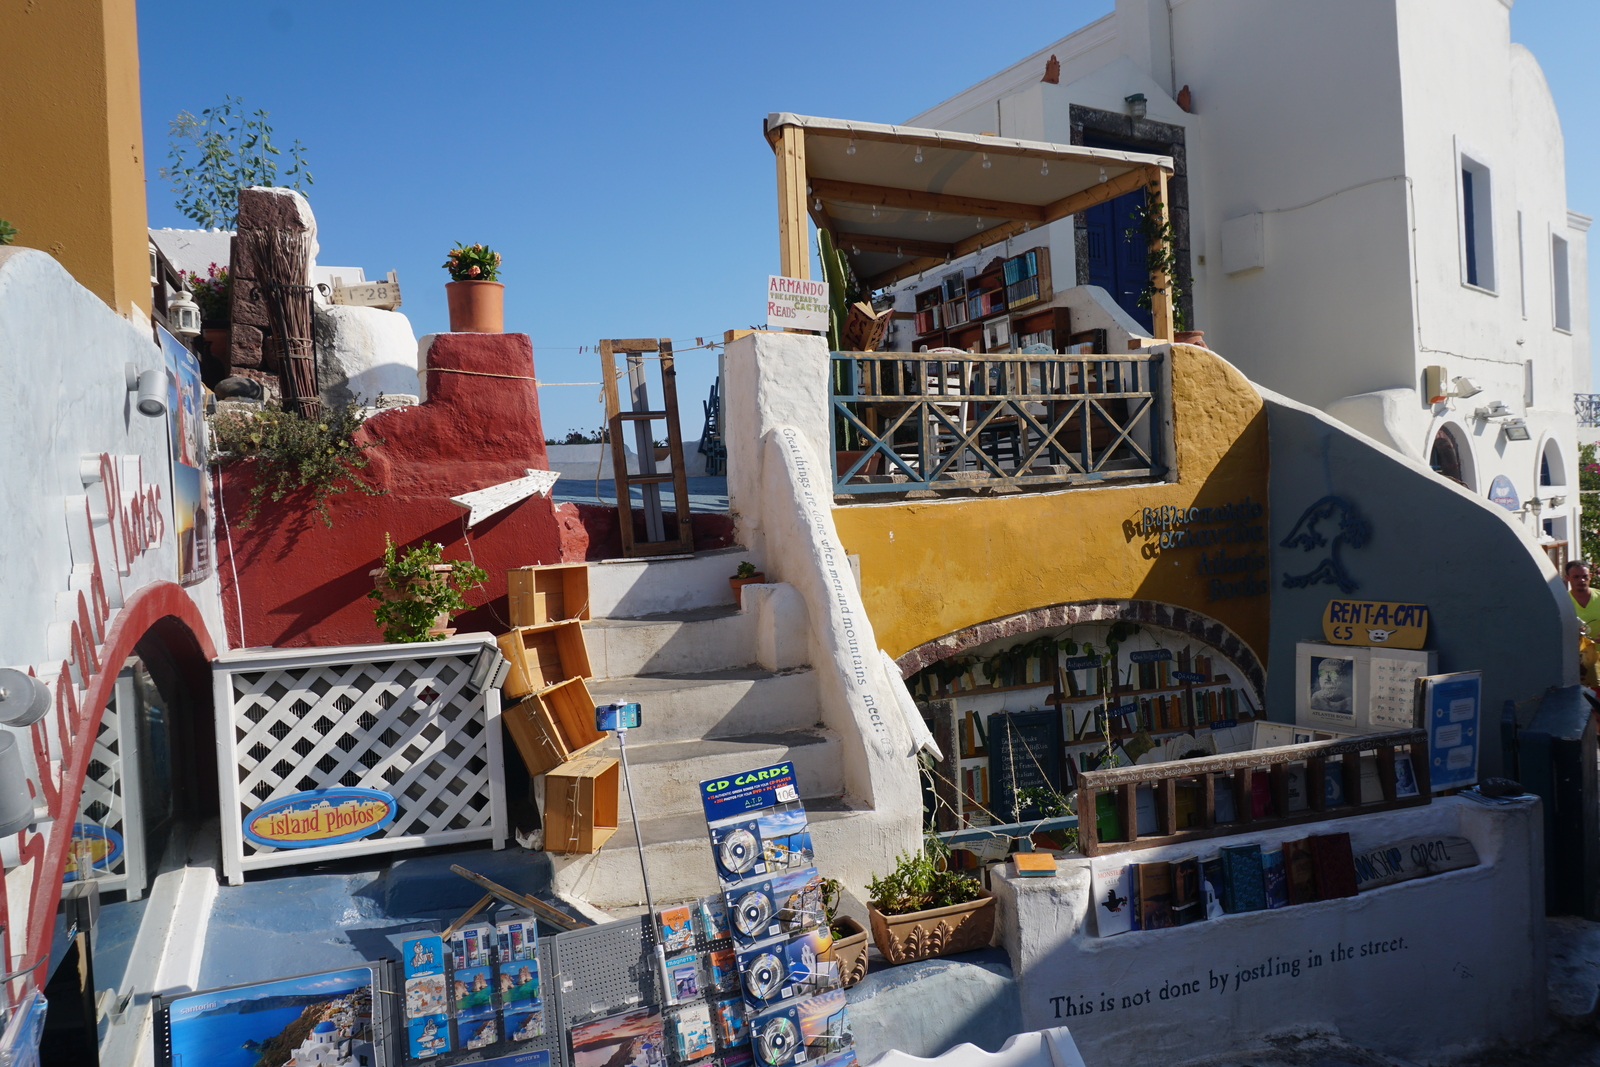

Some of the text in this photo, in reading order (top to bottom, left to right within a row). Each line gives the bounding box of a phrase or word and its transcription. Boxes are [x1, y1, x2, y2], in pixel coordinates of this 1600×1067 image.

[770, 278, 824, 296] ARMANDO
[784, 294, 819, 303] LITERARY
[794, 302, 828, 313] CACTUS
[783, 428, 798, 453] Great
[795, 452, 811, 489] things
[805, 488, 816, 508] are
[812, 509, 827, 537] done
[821, 538, 835, 568] when
[1197, 549, 1266, 575] Atlantis
[829, 568, 843, 592] men
[1210, 572, 1267, 601] Books
[838, 591, 850, 616] and
[1330, 601, 1428, 627] RENT-A-CAT
[1333, 626, 1353, 640] €5
[842, 615, 867, 686] mountains
[1177, 672, 1199, 681] DRAMA
[707, 766, 790, 792] CD CARDS
[1087, 778, 1102, 787] Our
[1105, 772, 1139, 786] handmade
[1142, 770, 1162, 779] books
[1164, 765, 1191, 777] designed
[1202, 763, 1209, 772] be
[1227, 760, 1233, 769] by
[1235, 758, 1248, 766] mail
[270, 806, 374, 836] island photos
[1410, 840, 1451, 873] Open
[1098, 868, 1125, 879] MONSTERS
[667, 957, 693, 967] magnets
[1051, 996, 1094, 1019] This
[1099, 992, 1115, 1012] is
[1122, 988, 1151, 1009] not
[1159, 979, 1200, 1000] done
[1209, 969, 1229, 994] by
[1234, 957, 1301, 991] jostling
[1307, 950, 1323, 969] in
[1330, 943, 1354, 963] the
[180, 1001, 217, 1015] santorini
[514, 1054, 541, 1063] santorini
